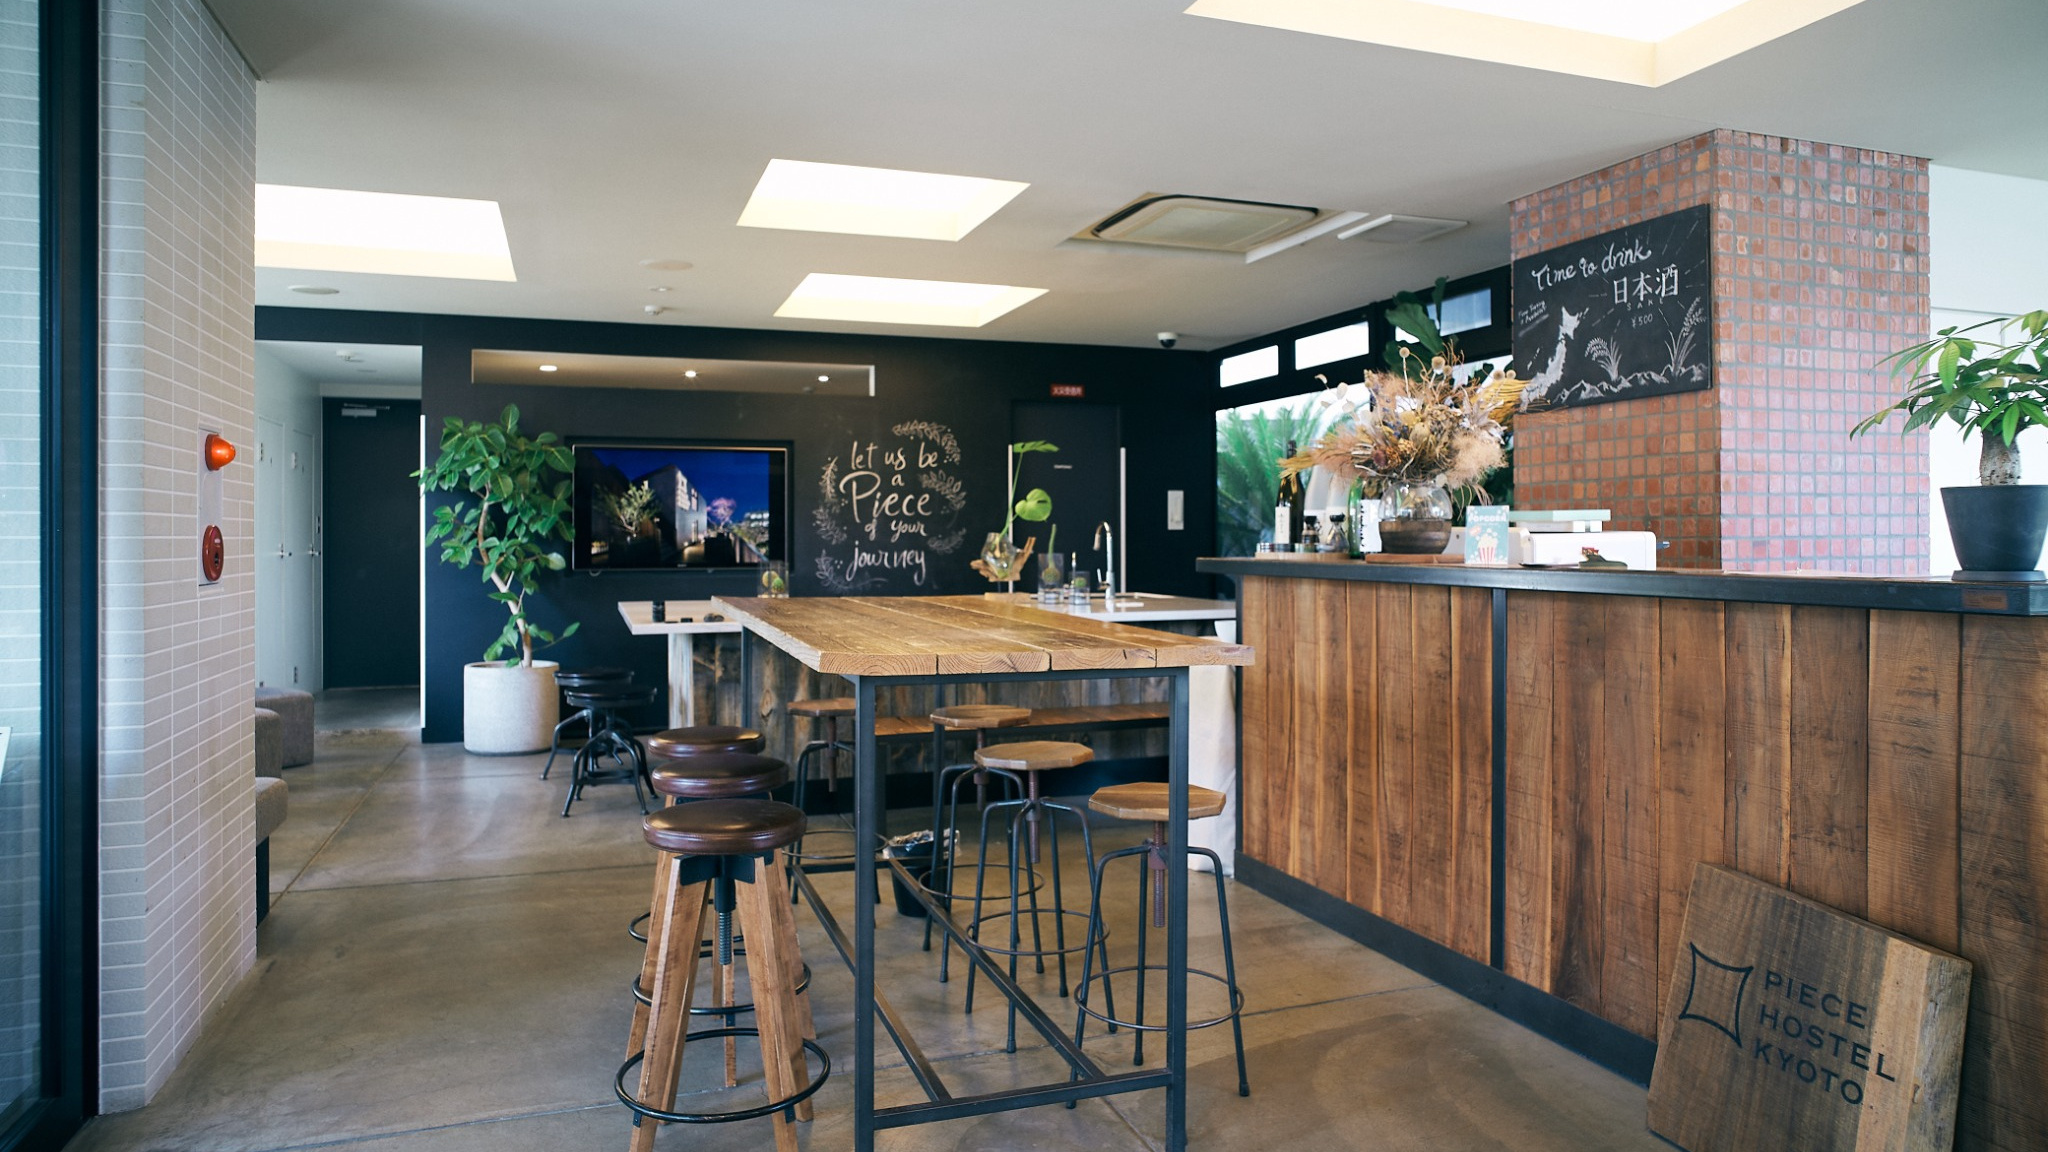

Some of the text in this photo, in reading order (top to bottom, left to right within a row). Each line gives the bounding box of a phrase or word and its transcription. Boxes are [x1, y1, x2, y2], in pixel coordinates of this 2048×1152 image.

[1531, 238, 1653, 291] Time to drink
[1613, 263, 1679, 305] 日本酒
[1631, 313, 1653, 329] ¥500
[851, 441, 939, 471] let us be
[839, 470, 932, 523] Piece
[891, 473, 905, 487] a
[864, 518, 928, 543] of your
[846, 540, 927, 586] journey
[1764, 969, 1868, 1030] PIECE
[1760, 1003, 1895, 1082] HOSTEL
[1753, 1037, 1864, 1105] KYOTO
